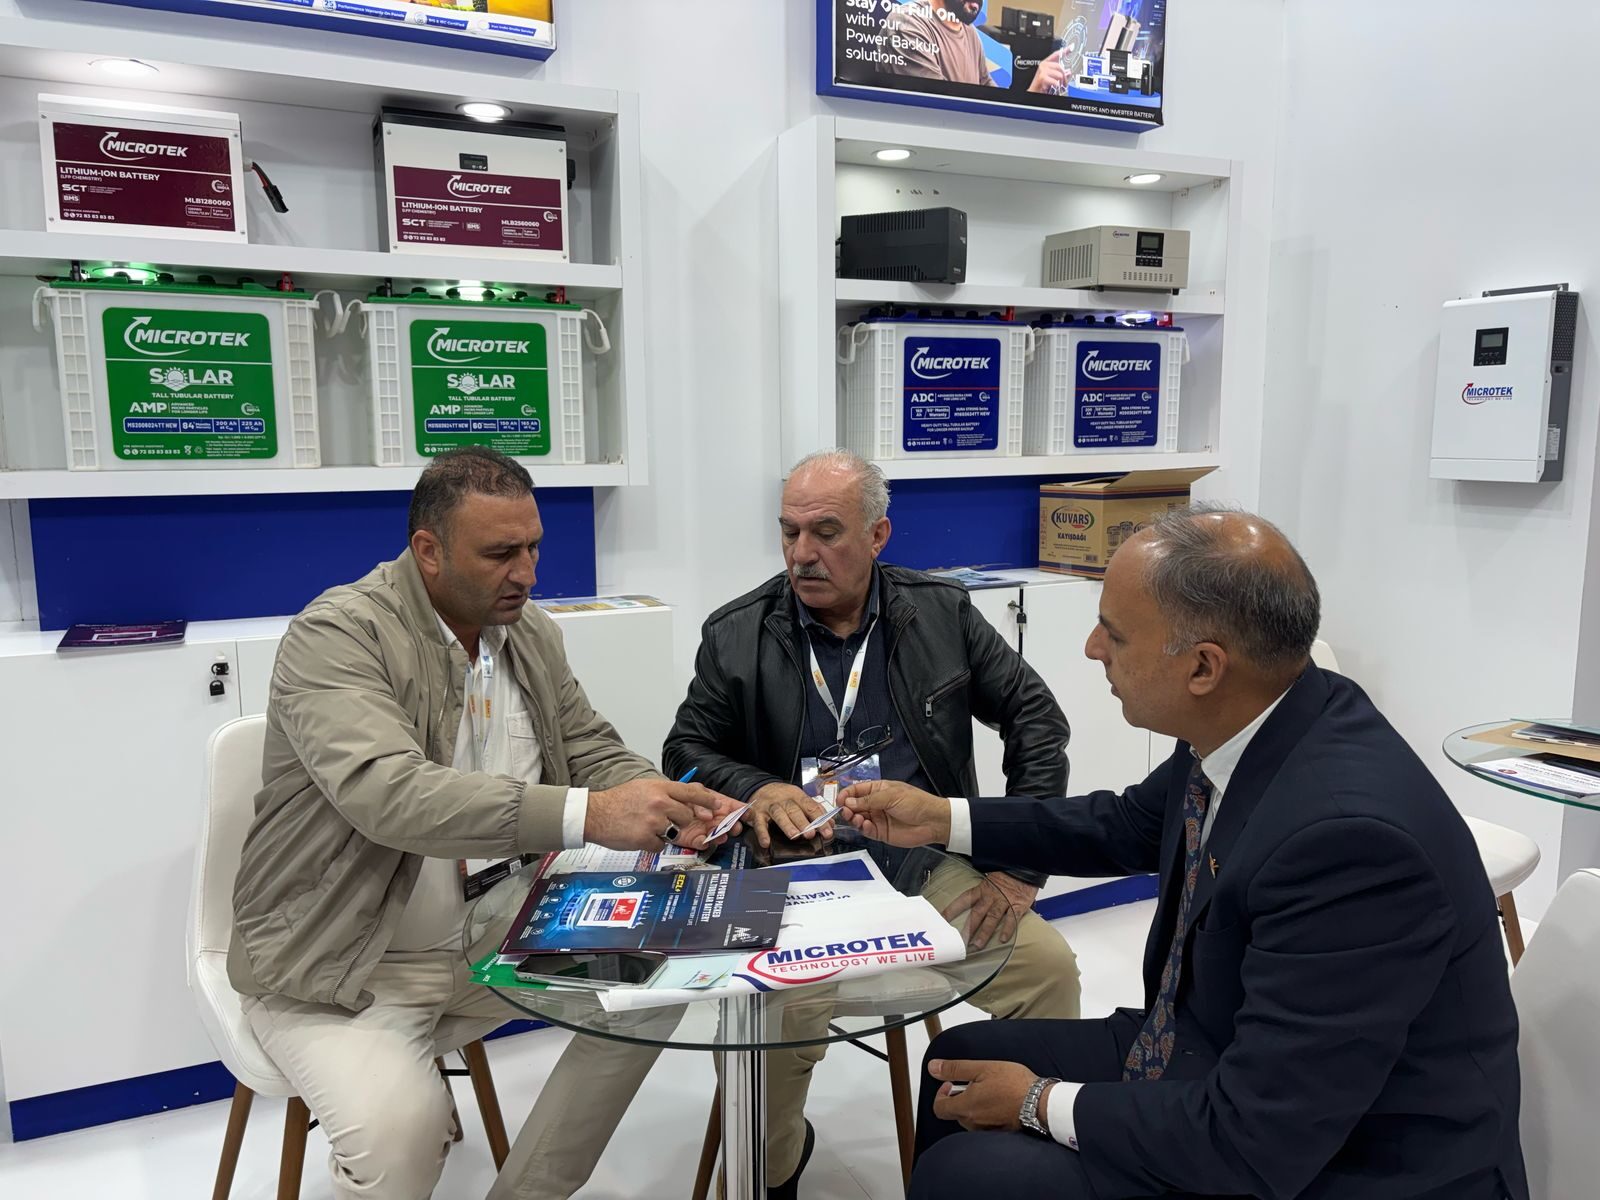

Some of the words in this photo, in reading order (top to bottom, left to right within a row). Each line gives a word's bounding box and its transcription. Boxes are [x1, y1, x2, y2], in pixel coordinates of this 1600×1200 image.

[909, 4, 933, 18] Full
[845, 12, 875, 27] with
[879, 19, 900, 31] our
[846, 28, 888, 46] Power
[892, 35, 939, 55] Backup
[846, 46, 907, 66] solutions.
[1071, 104, 1098, 113] INVERTERS
[1110, 108, 1133, 117] INVERTER
[1134, 111, 1155, 119] BATTERY
[106, 140, 188, 158] MICROTEK
[60, 167, 117, 178] LITHIUM-ION
[119, 171, 160, 181] BATTERY
[62, 184, 87, 192] SCT
[453, 182, 512, 194] MICROTEK
[402, 202, 448, 211] LITHIUM-ION
[450, 205, 482, 213] BATTERY
[402, 218, 426, 226] SCT
[134, 329, 250, 347] MICROTEK
[436, 339, 530, 353] MICROTEK
[917, 357, 990, 370] MICROTEK
[1087, 360, 1152, 371] MICROTEK
[149, 367, 234, 384] SOLAR
[447, 374, 515, 388] SOLAR
[911, 393, 934, 402] ADC
[1082, 393, 1103, 402] ADC
[1466, 387, 1513, 396] MICROTEK
[129, 402, 168, 413] AMP
[430, 405, 460, 415] AMP
[1056, 513, 1089, 524] KUVARS
[720, 873, 730, 885] MTEK
[705, 884, 718, 902] TUBULAR
[717, 885, 727, 900] POWER
[689, 906, 697, 918] BATTERY
[700, 903, 713, 922] BATTERY
[712, 901, 724, 918] PACKED
[767, 931, 932, 965] MICROTEK
[772, 958, 869, 974] TECHNOLOGY
[877, 955, 898, 964] WE
[906, 952, 936, 962] LIVE
